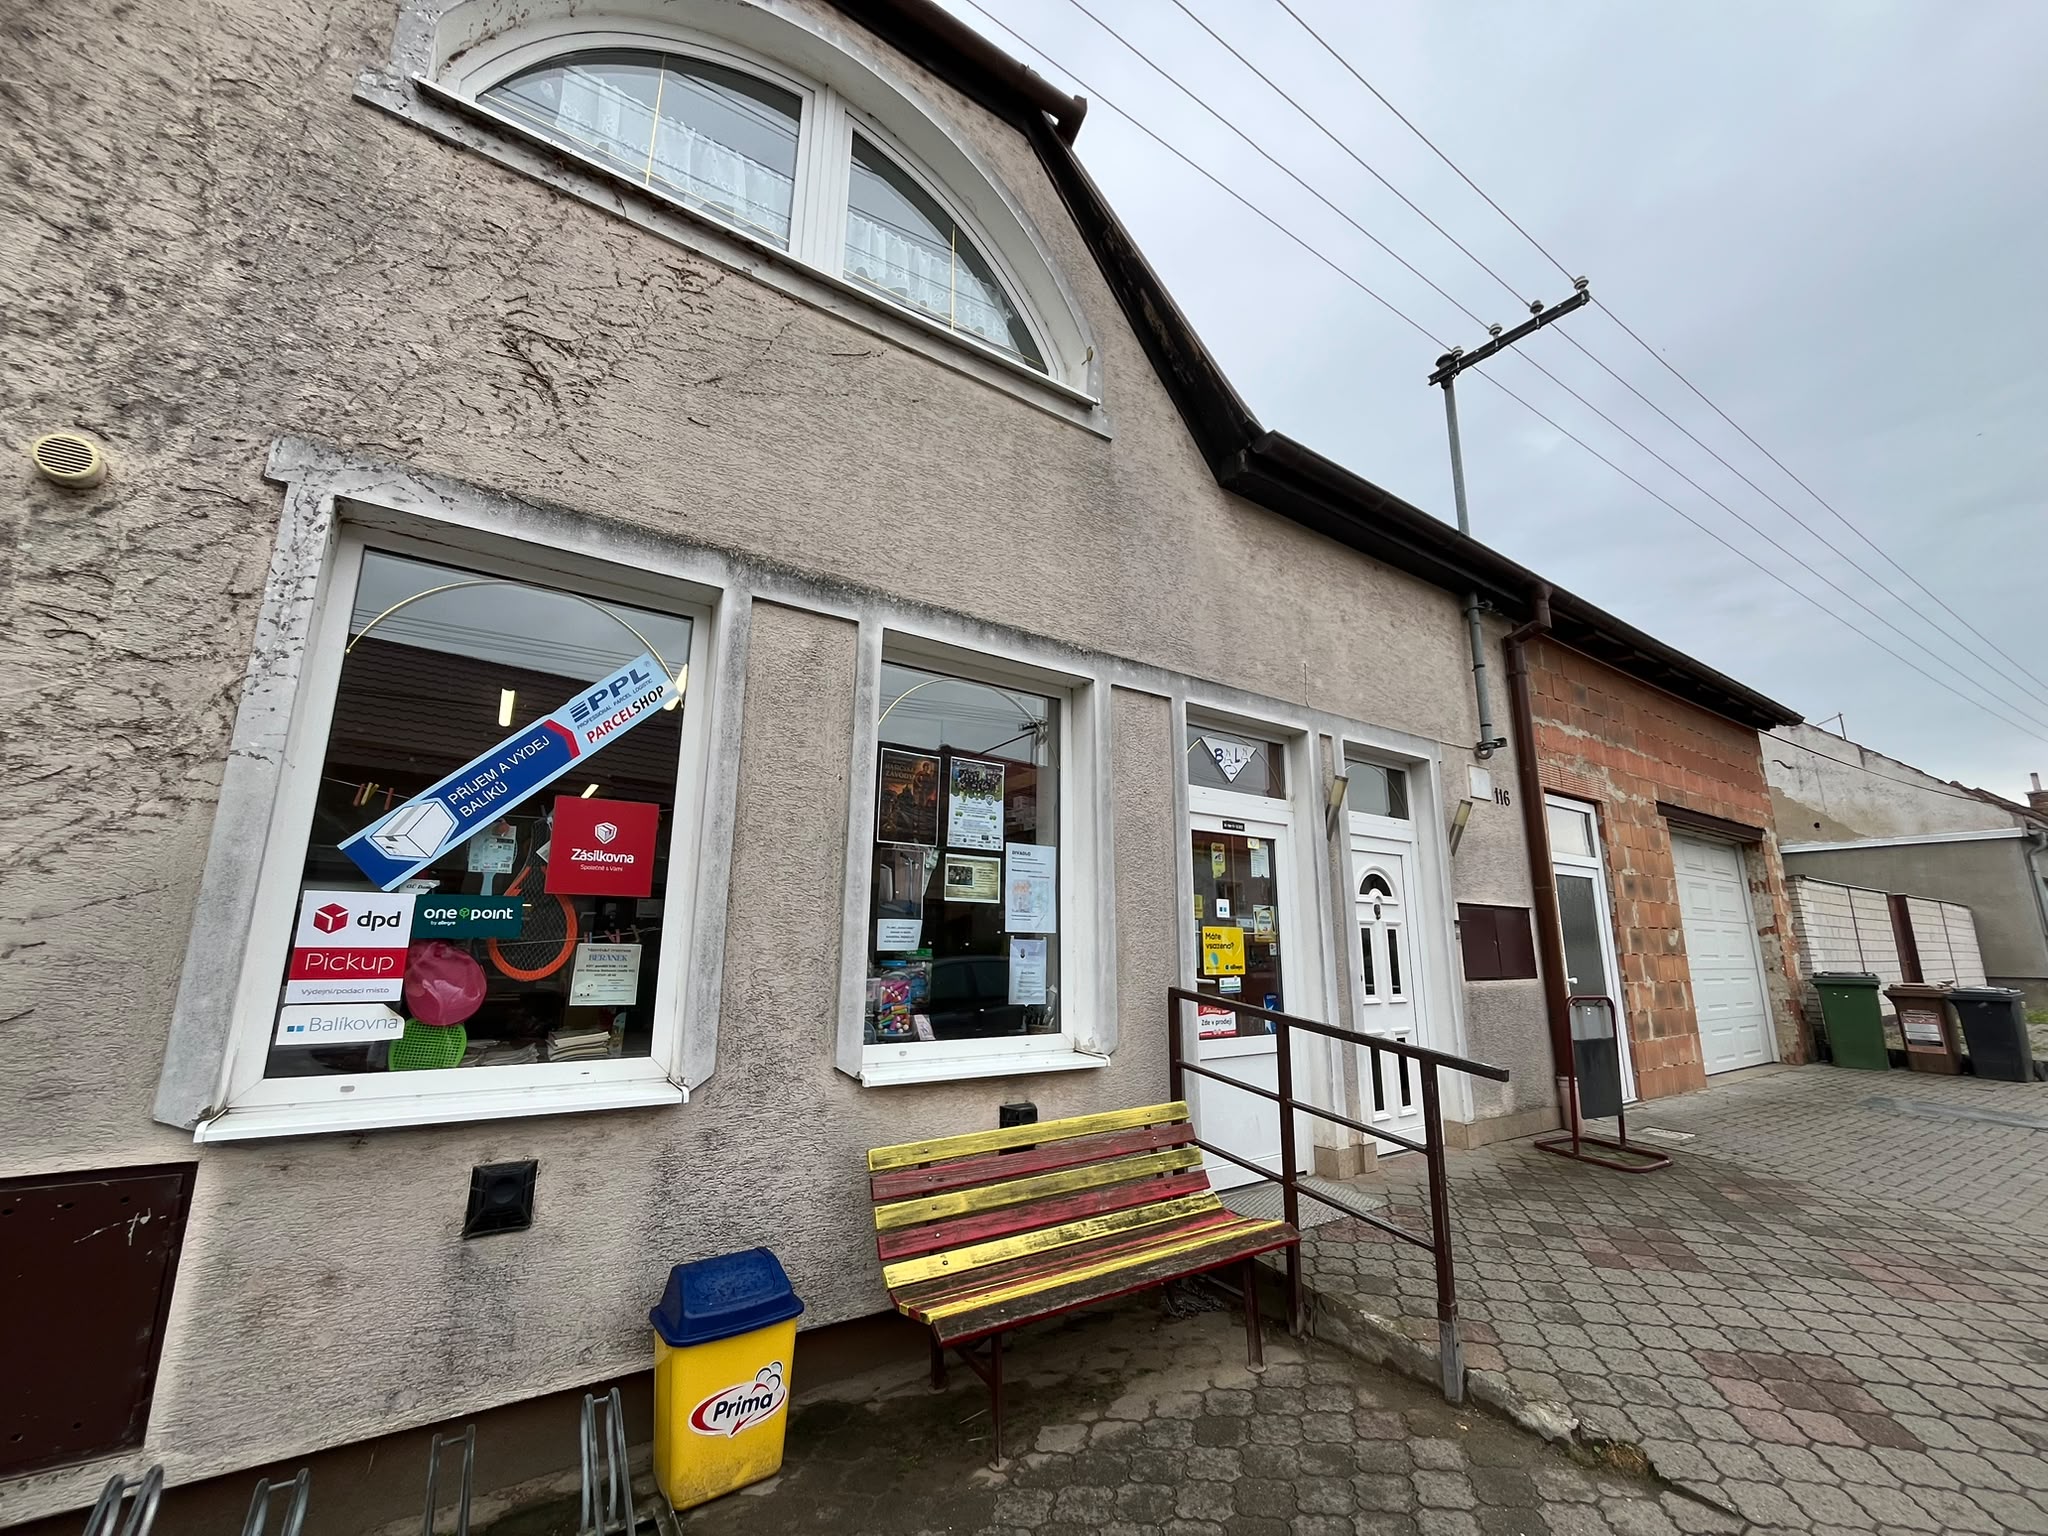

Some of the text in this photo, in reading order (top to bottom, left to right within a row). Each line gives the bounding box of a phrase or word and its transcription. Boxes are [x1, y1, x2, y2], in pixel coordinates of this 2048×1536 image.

[587, 668, 650, 712] PPL
[577, 678, 653, 730] PROFESSIONAL PARCEL LOGISTIC
[586, 685, 664, 744] PARCELSHOP
[447, 735, 550, 805] PŘÍJEM A VÝDEJ
[460, 781, 508, 818] BALÍKŮ
[1494, 787, 1511, 806] 116
[571, 848, 634, 864] Zásilkovna
[357, 910, 401, 931] dpd
[424, 907, 513, 920] one point
[305, 953, 394, 974] Pickup
[309, 1017, 398, 1032] Balíkovna
[712, 1391, 773, 1422] Prima
